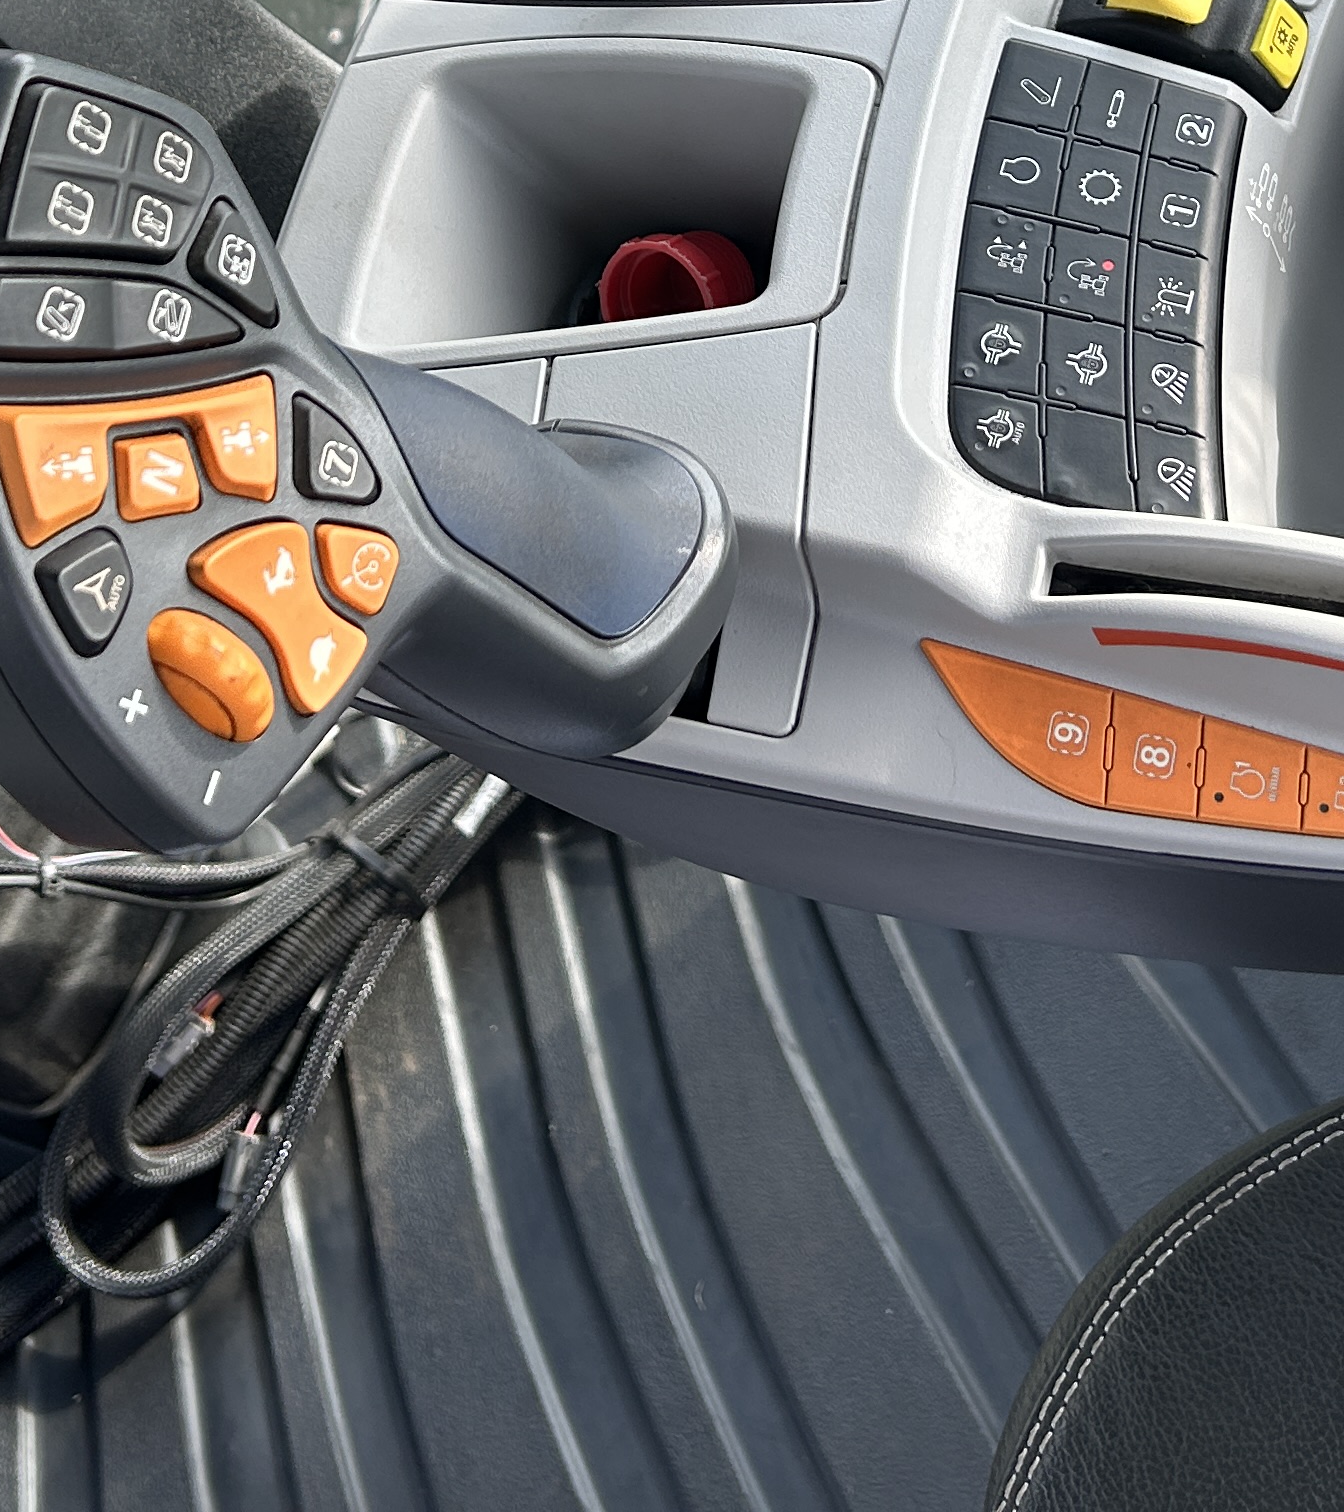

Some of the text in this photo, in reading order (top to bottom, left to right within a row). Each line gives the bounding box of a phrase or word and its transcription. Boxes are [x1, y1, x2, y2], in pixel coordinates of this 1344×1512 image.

[1285, 33, 1299, 59] AUTO
[1181, 120, 1210, 141] 2
[1166, 204, 1194, 217] 1
[1155, 368, 1171, 380] 2
[1011, 421, 1026, 446] AUTO
[140, 449, 185, 496] N
[108, 574, 126, 613] AUTO
[1054, 722, 1084, 745] 9
[1140, 744, 1171, 769] 8
[1234, 761, 1252, 769] 1
